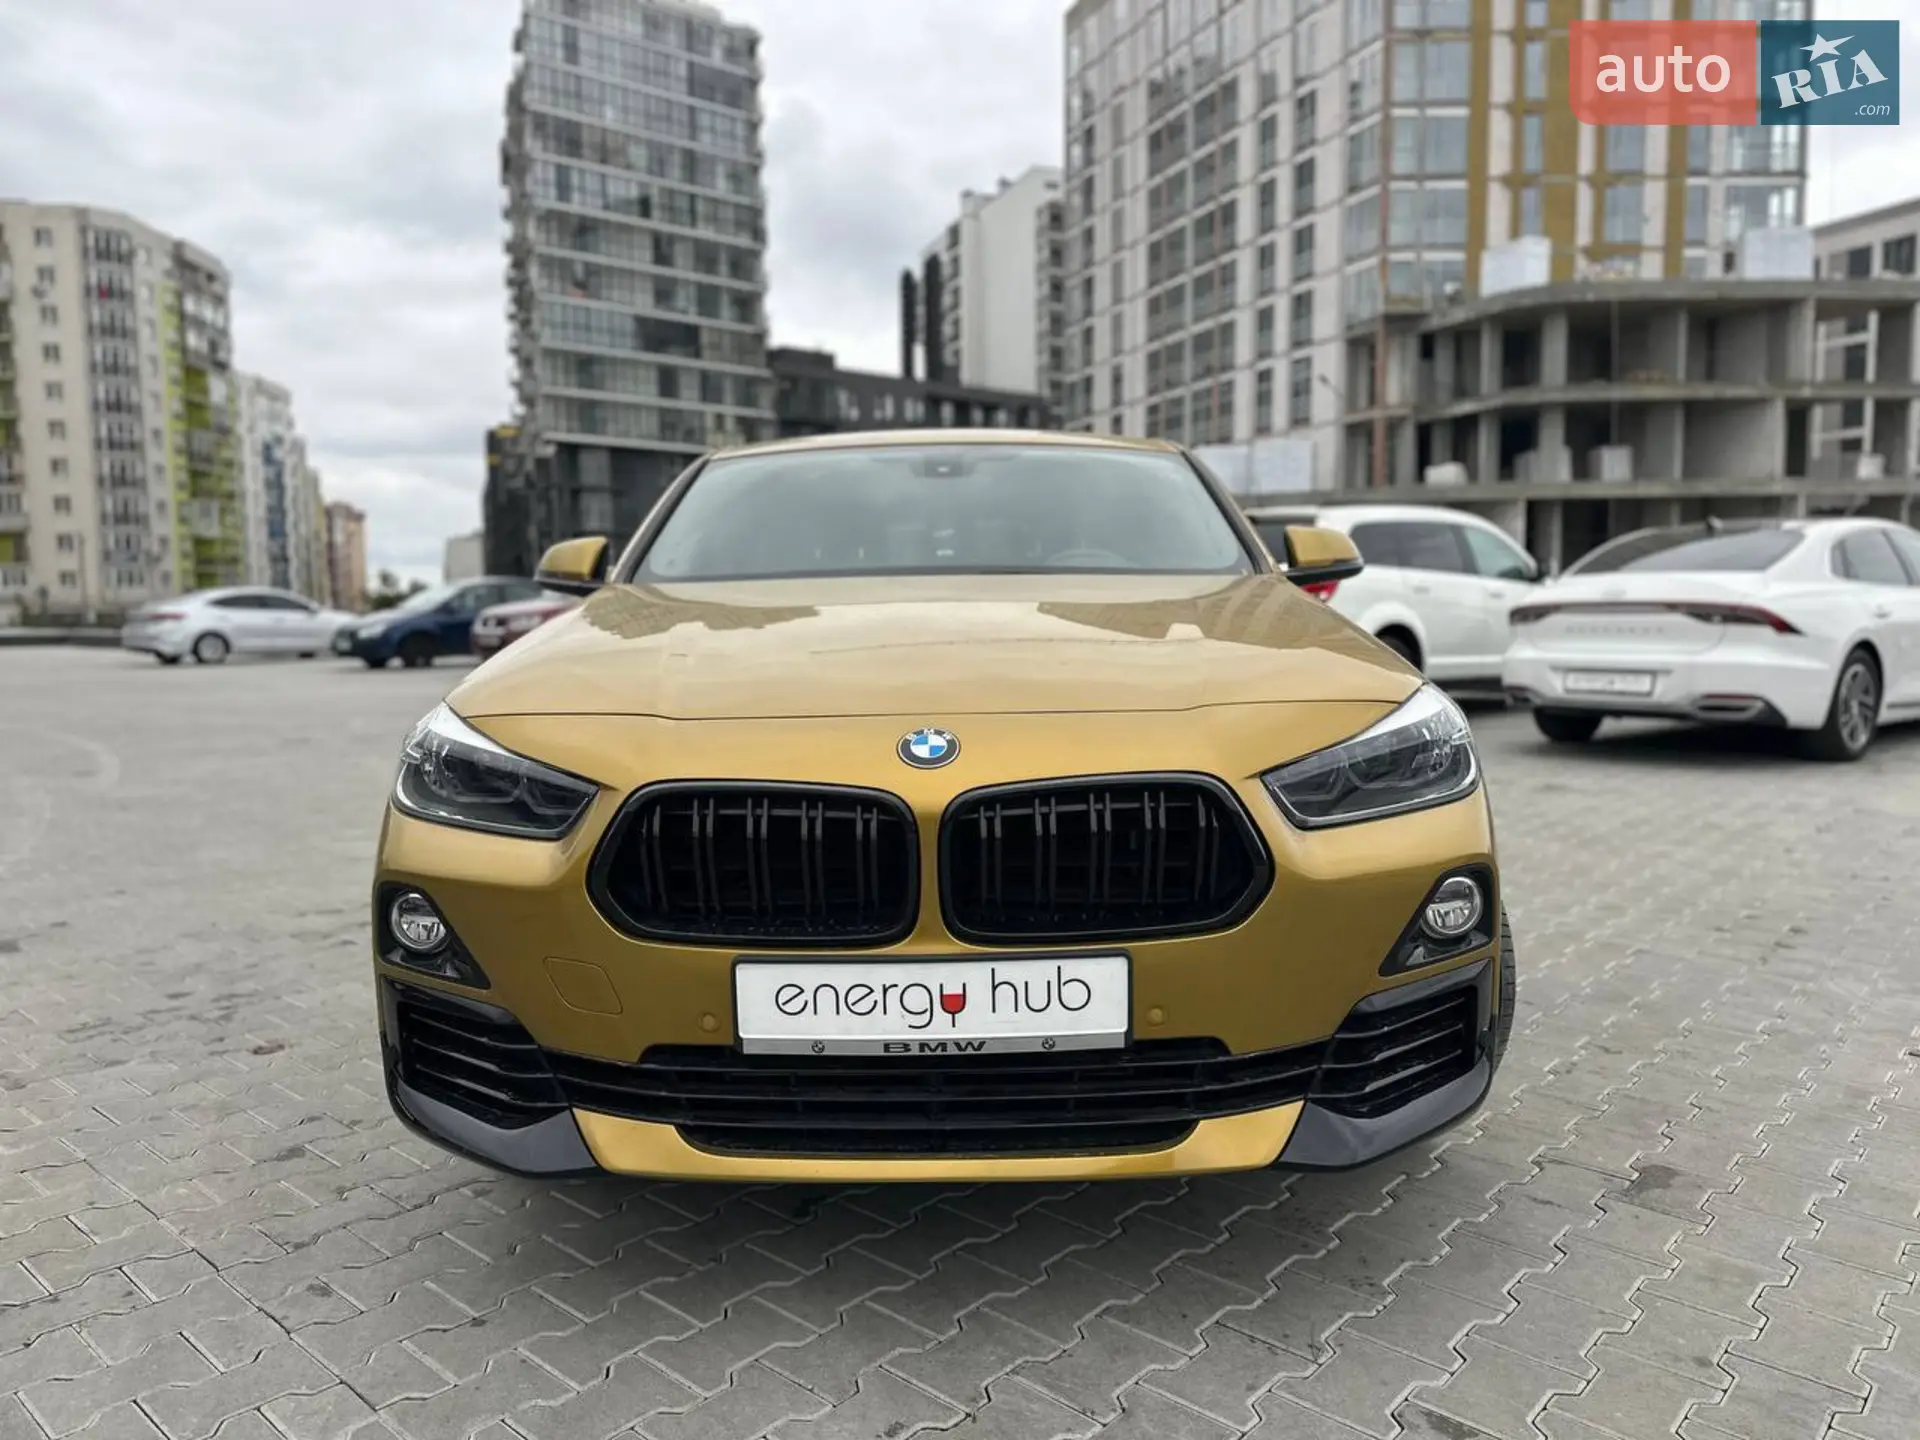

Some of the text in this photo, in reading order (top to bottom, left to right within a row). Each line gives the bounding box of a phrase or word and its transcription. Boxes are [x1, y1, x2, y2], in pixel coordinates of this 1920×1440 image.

[775, 965, 1091, 1029] energy hub
[883, 1041, 986, 1054] BMW
